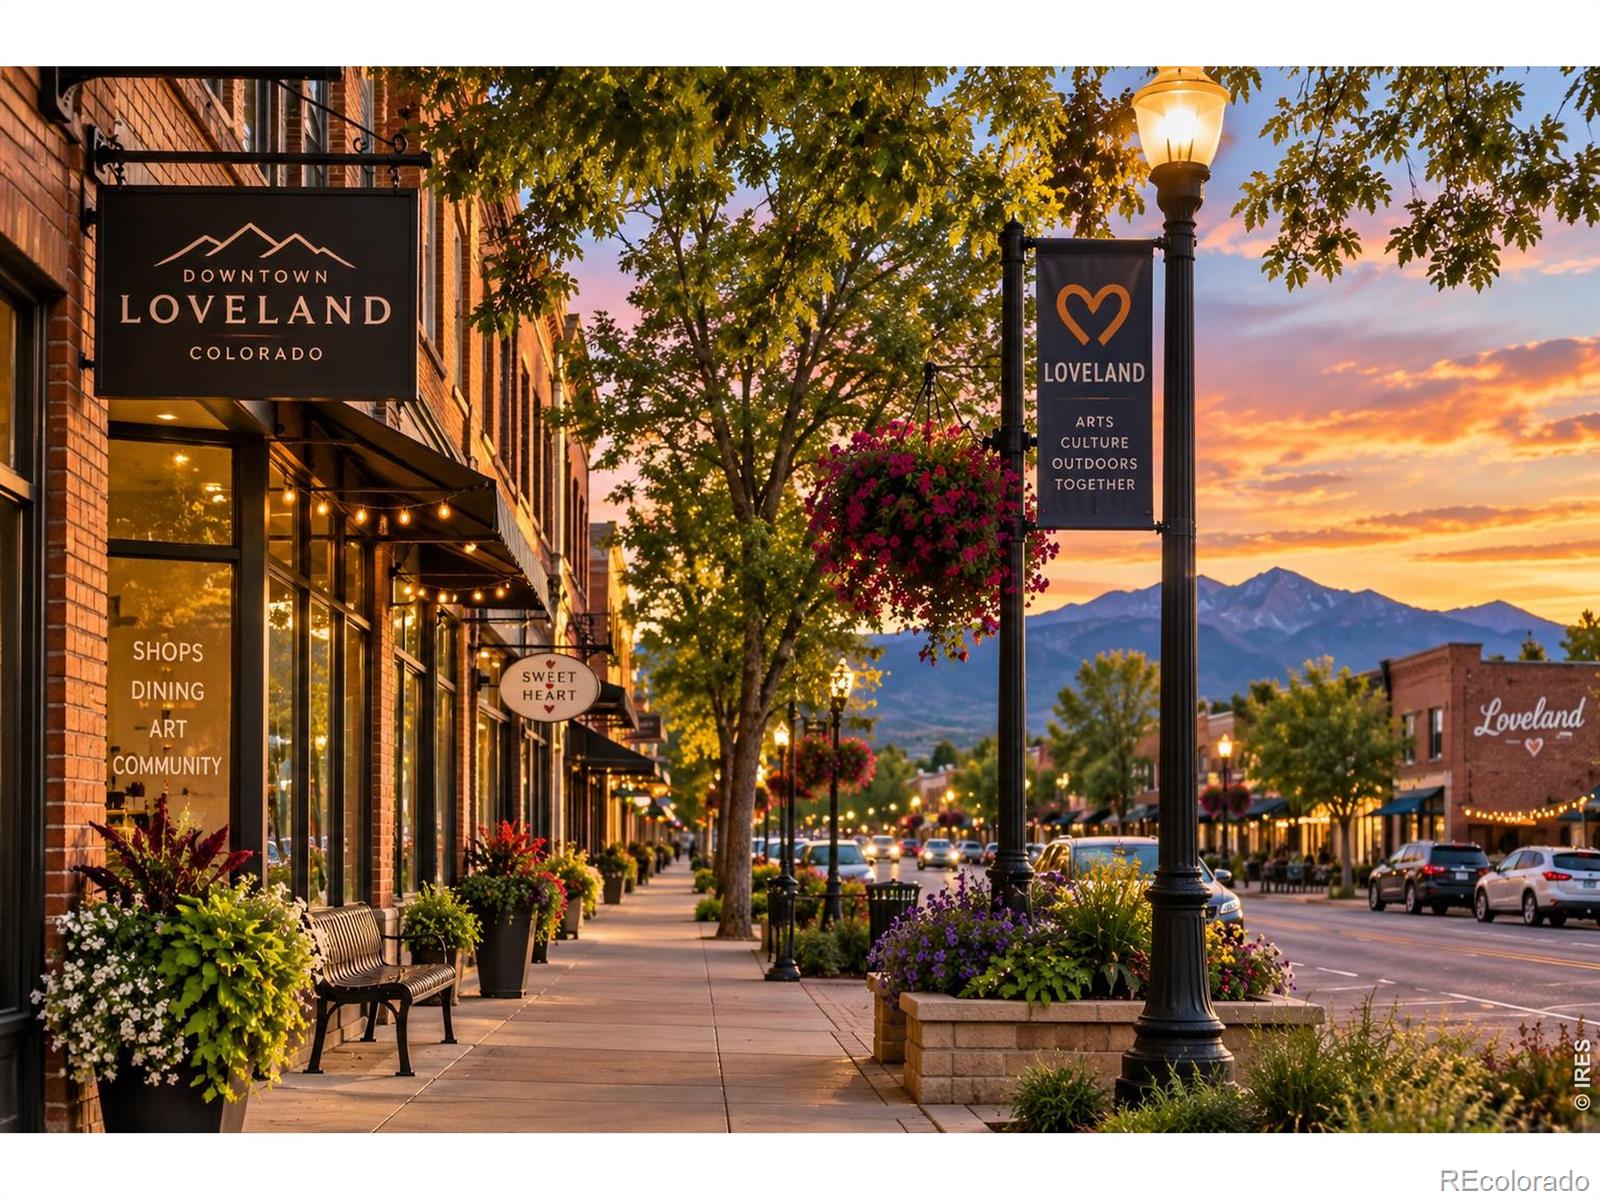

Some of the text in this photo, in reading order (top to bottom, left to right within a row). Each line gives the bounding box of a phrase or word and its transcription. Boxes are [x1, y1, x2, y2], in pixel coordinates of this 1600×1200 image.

[183, 269, 329, 284] DOWNTOWN
[120, 294, 392, 326] LOVELAND
[189, 346, 324, 362] COLORADO
[1044, 362, 1146, 383] LOVELAND
[1075, 415, 1114, 429] ARTS
[1060, 436, 1129, 449] CULTURE
[1051, 457, 1138, 471] OUTDOORS
[1054, 478, 1136, 491] TOGETHER
[132, 640, 204, 663] SHOPS
[522, 671, 577, 683] SWEET
[131, 680, 205, 702] DINING
[522, 689, 577, 701] HEART
[1473, 695, 1587, 737] Loveland
[149, 719, 188, 740] ART
[112, 755, 223, 777] COMMUNITY
